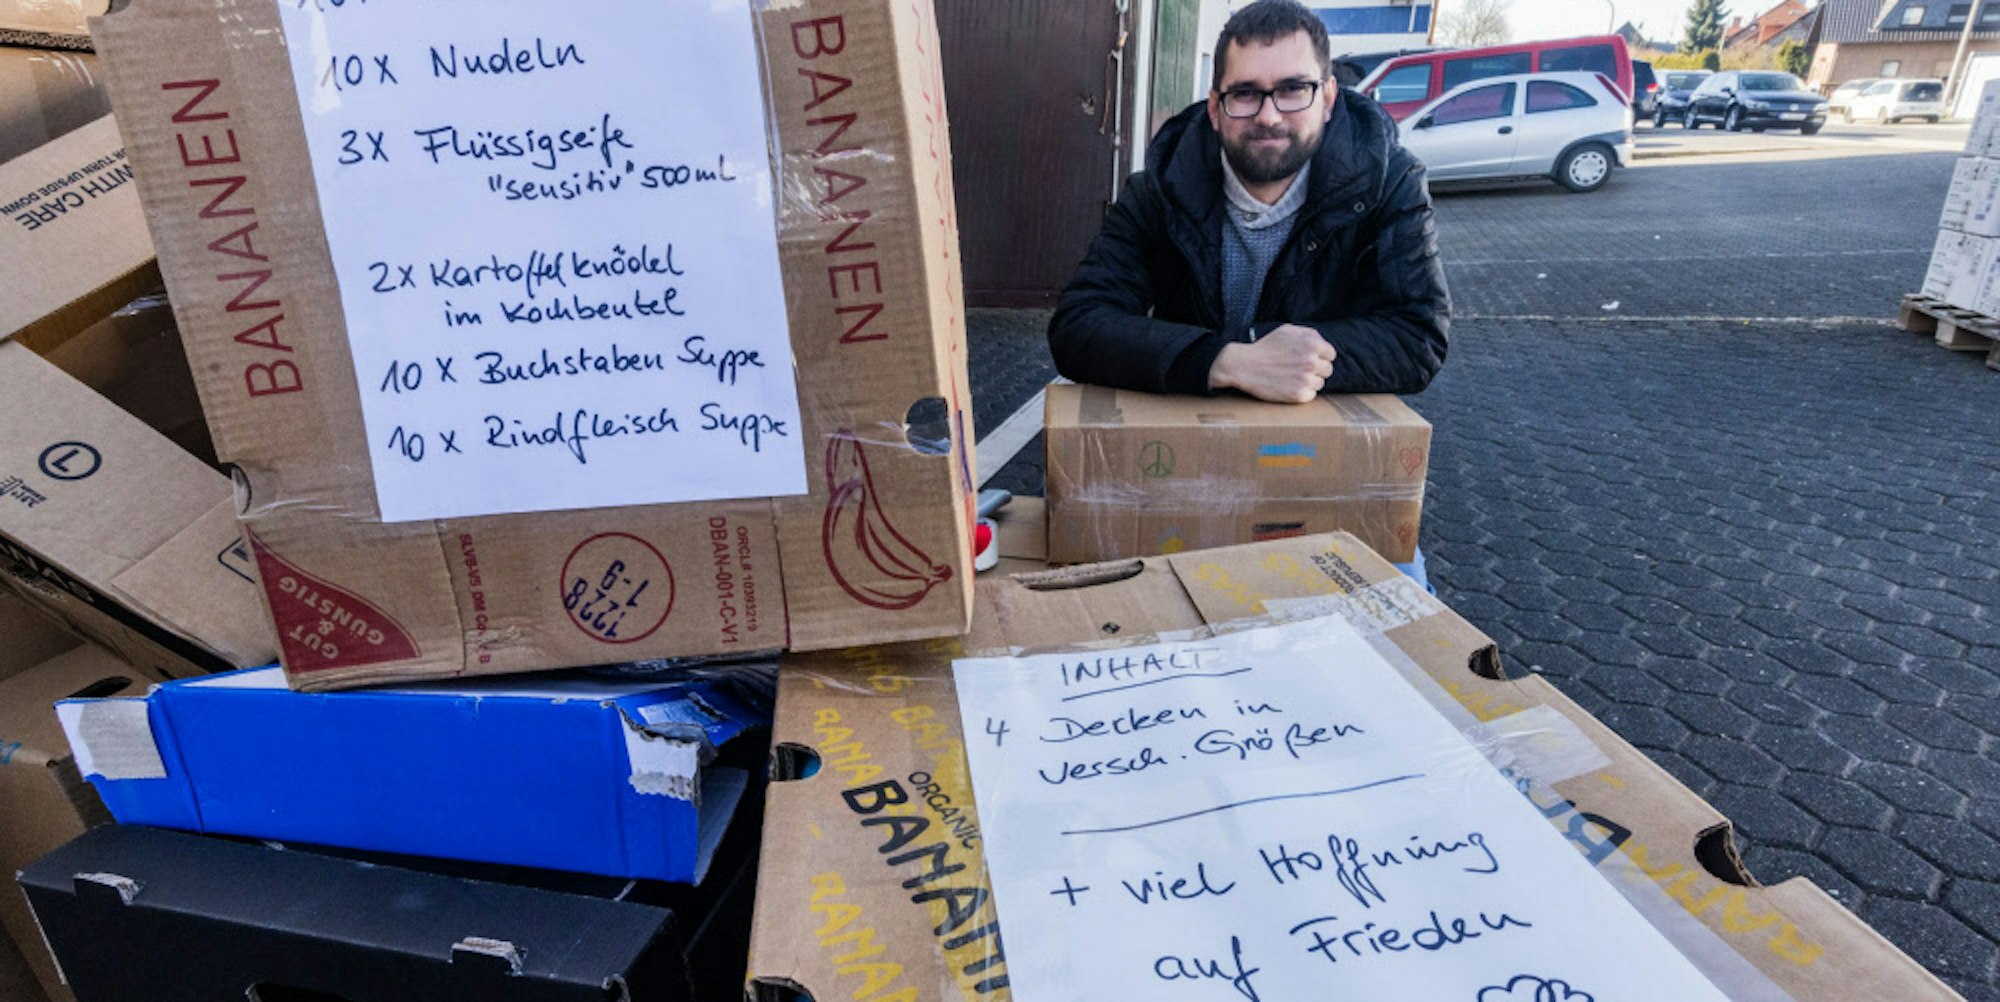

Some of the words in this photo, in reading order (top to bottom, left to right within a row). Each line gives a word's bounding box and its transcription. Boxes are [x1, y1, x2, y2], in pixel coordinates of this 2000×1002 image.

[430, 38, 585, 79] Nudeln
[414, 113, 634, 170] Flüssigseife
[38, 171, 84, 196] UPSIDE
[80, 163, 134, 198] WITH
[81, 156, 116, 175] TURN
[790, 14, 888, 345] BANANEN
[0, 192, 40, 215] DOWN
[14, 191, 84, 231] CARE
[161, 78, 303, 397] BANANEN
[446, 301, 482, 327] im
[499, 288, 686, 324] Kochbeutel
[381, 360, 422, 392] 10
[475, 346, 665, 385] Buchstaben
[677, 335, 765, 385] Suppe
[388, 426, 425, 462] 10
[484, 408, 680, 464] Rindfleisch
[700, 403, 788, 452] Suppe
[709, 516, 739, 645] DBAN-001-C-V1
[278, 574, 386, 645] GÜNSTIG
[317, 618, 336, 634] &
[289, 625, 340, 660] GUT
[1062, 648, 1220, 686] INHALT
[986, 717, 1010, 747] 4
[1040, 706, 1207, 742] Decken
[1235, 700, 1283, 715] in
[1194, 723, 1365, 760] Größen
[1050, 876, 1090, 906] +
[1121, 862, 1236, 904] viel
[1259, 831, 1501, 908] Hoffnung
[1154, 936, 1260, 1002] auf
[1288, 911, 1532, 962] Frieden
